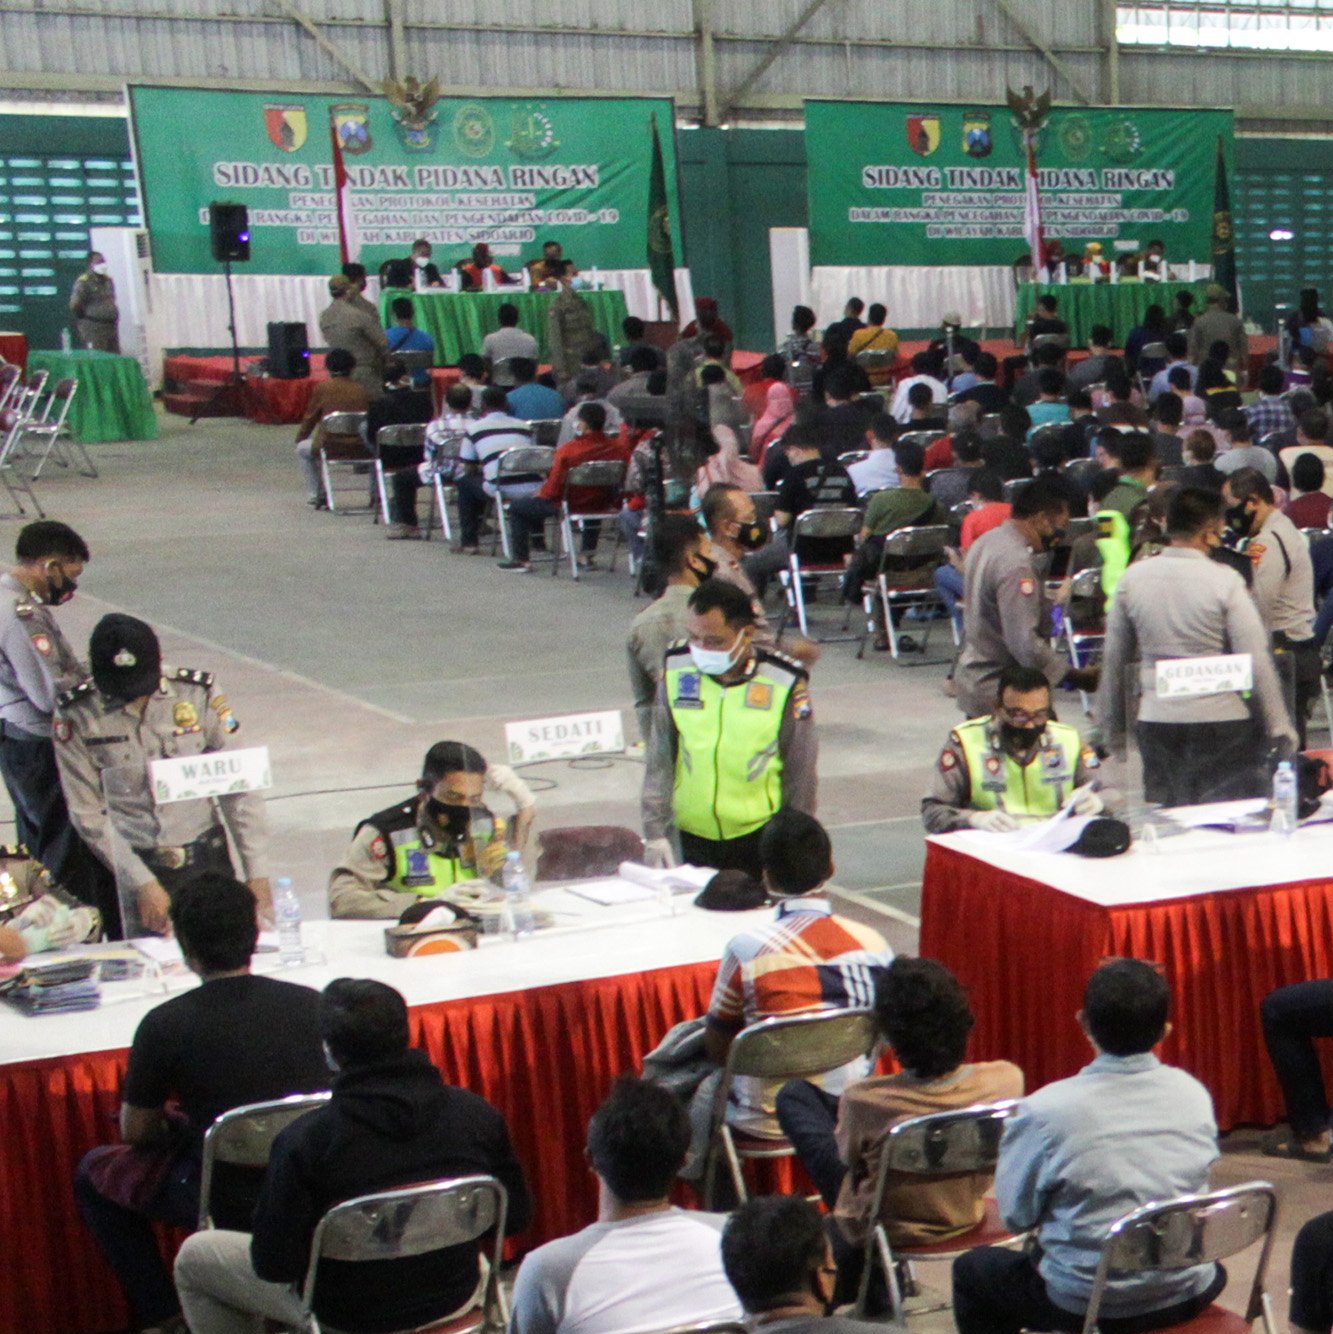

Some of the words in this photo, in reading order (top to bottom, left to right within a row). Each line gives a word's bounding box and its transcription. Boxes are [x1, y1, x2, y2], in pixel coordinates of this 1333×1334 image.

[215, 163, 311, 187] SIDANG
[316, 165, 409, 188] TNDAK
[416, 167, 505, 188] PIDANA
[510, 166, 598, 188] RINGAN
[864, 167, 940, 187] SIDANG
[945, 168, 1021, 188] TINDAK
[1037, 170, 1098, 188] IDANA
[1103, 170, 1174, 189] RINGAN
[1165, 663, 1243, 678] GEDANGAN
[527, 721, 604, 743] SEDATI
[180, 757, 242, 780] WARU
